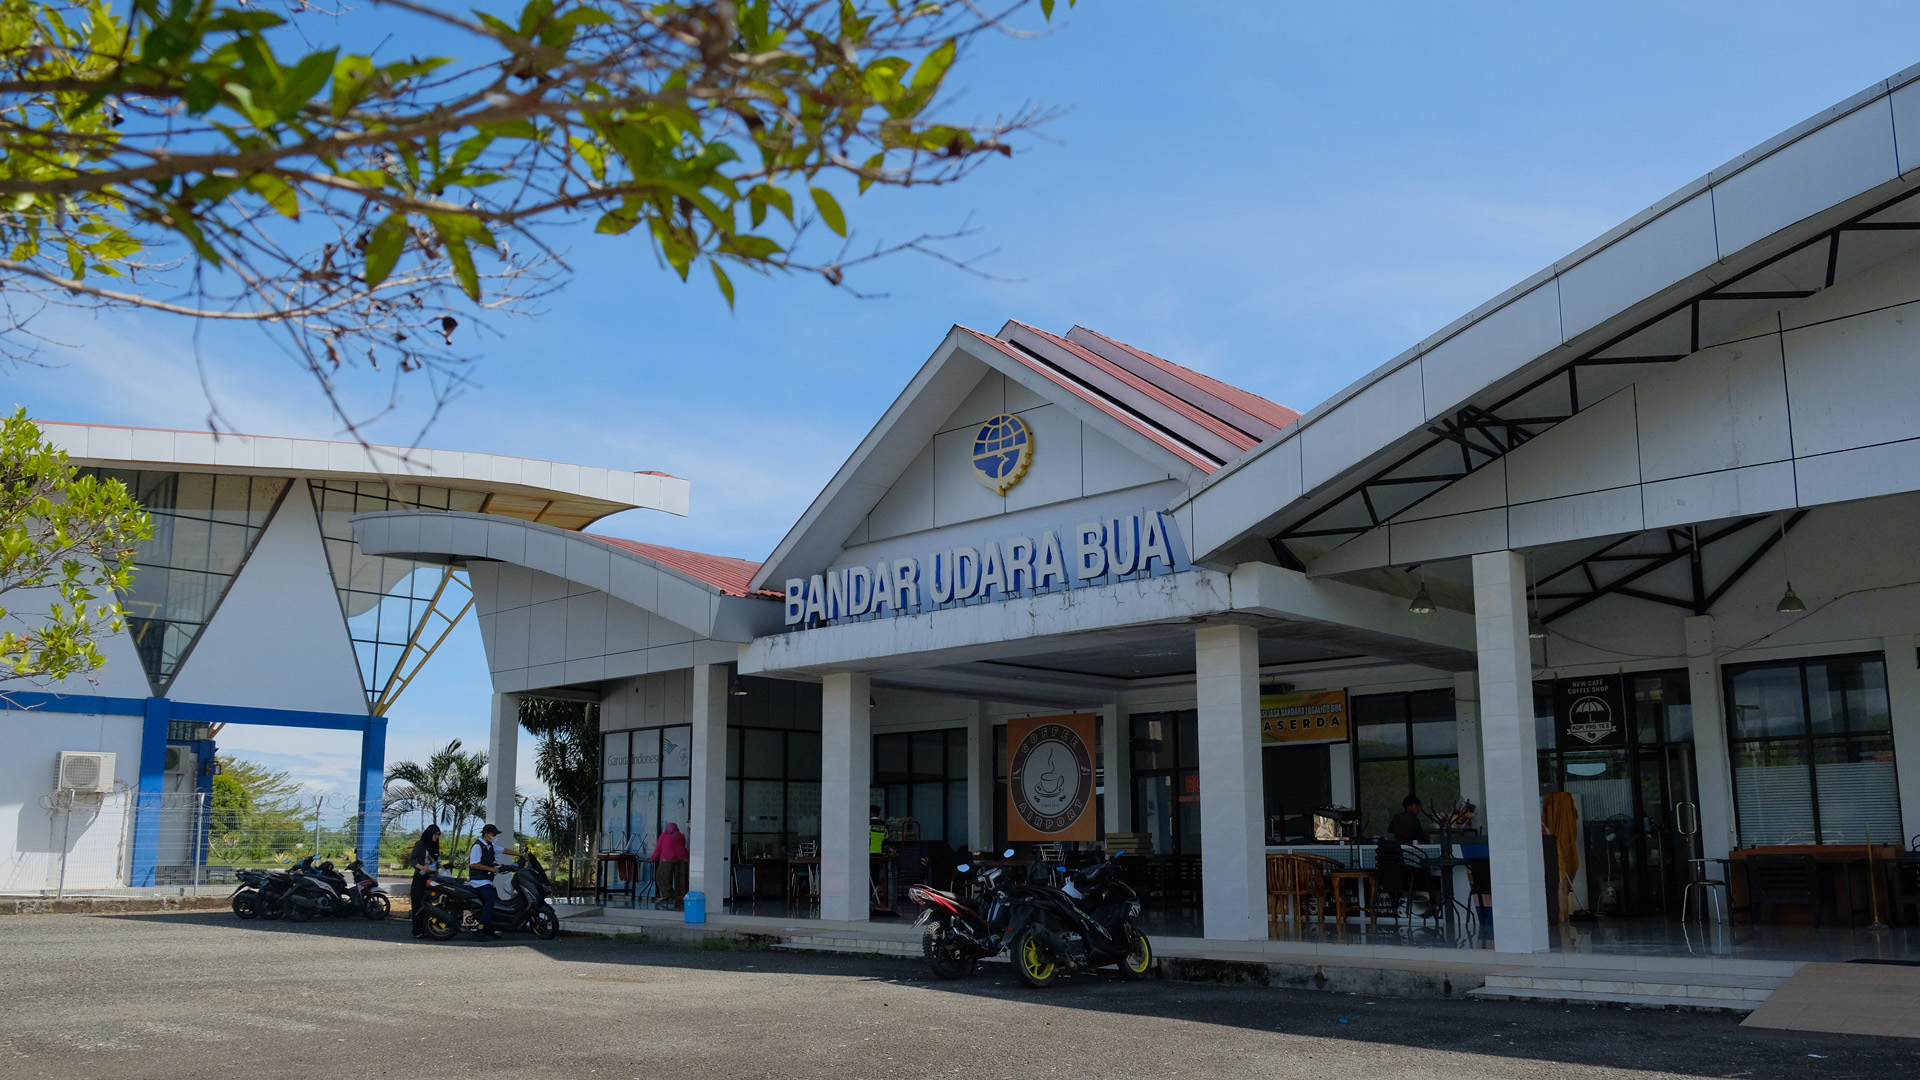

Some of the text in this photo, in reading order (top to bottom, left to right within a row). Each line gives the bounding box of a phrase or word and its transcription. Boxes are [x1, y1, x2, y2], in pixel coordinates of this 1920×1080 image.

[784, 510, 1175, 625] BANDAR UDARA BUA
[1591, 685, 1609, 693] SHOP
[1281, 706, 1304, 717] BANDARA
[1021, 726, 1080, 753] COFFEE
[632, 753, 659, 765] Indones
[1018, 798, 1083, 829] AIRPORT
